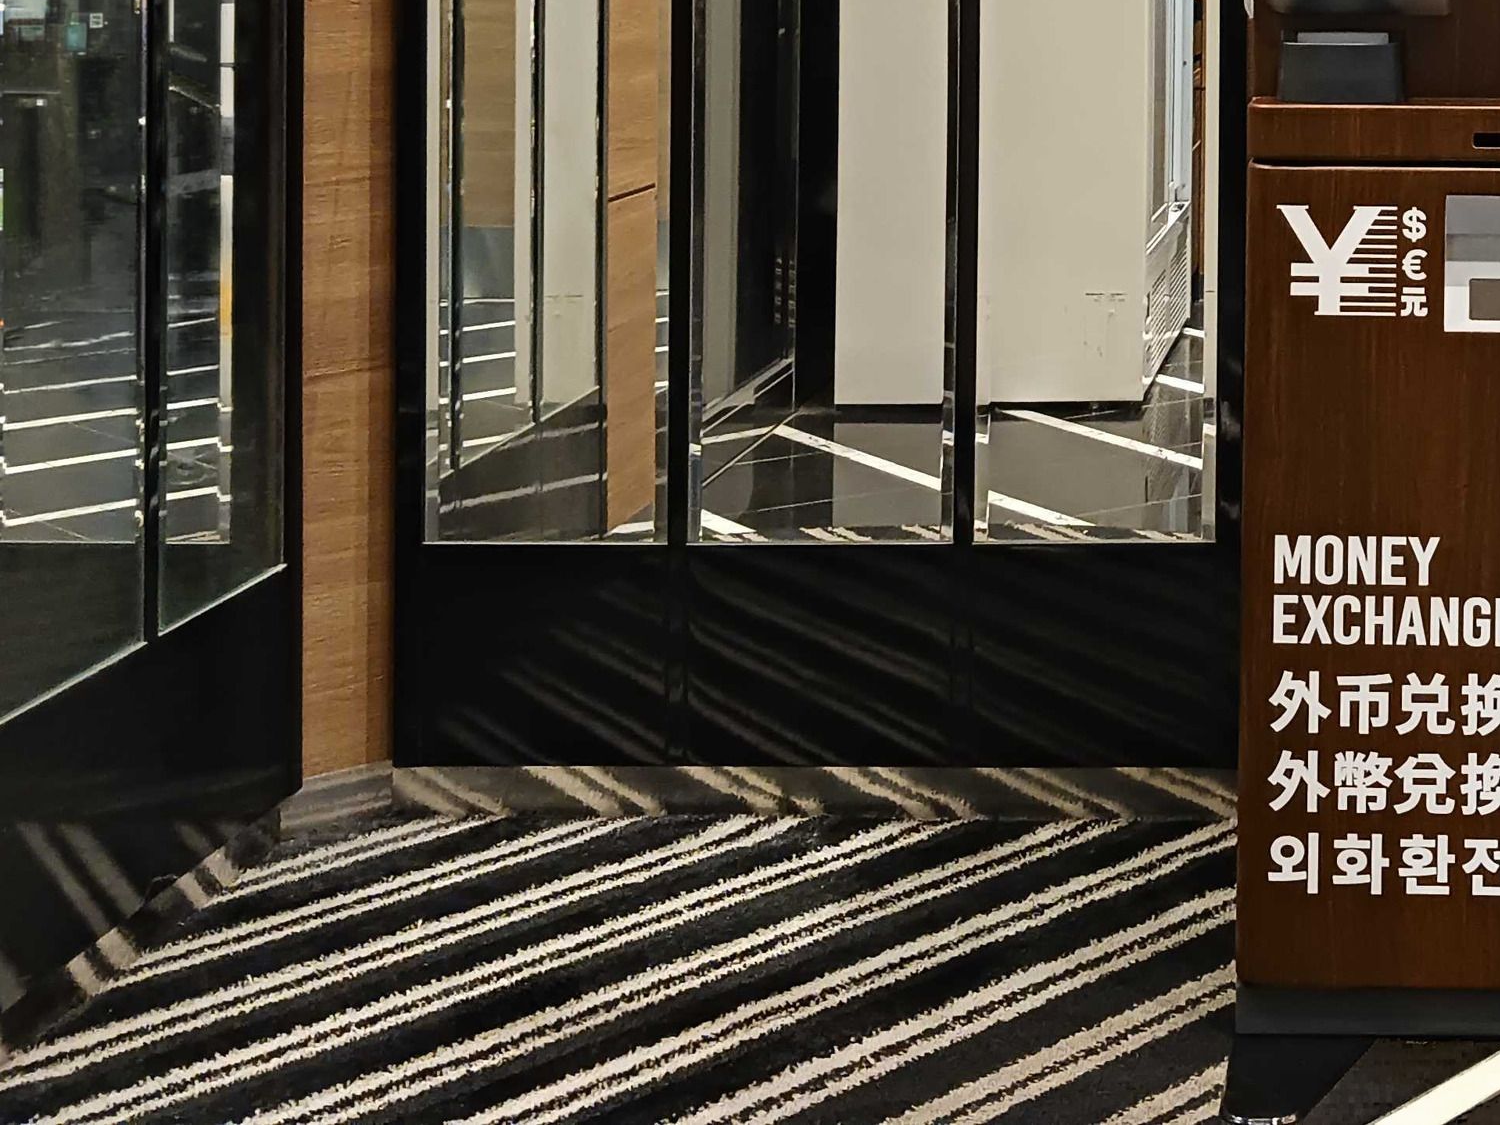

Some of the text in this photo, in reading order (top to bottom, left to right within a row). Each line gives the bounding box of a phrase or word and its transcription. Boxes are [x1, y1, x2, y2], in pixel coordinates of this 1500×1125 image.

[1402, 206, 1427, 242] $
[1402, 248, 1428, 281] €
[1400, 286, 1428, 317] 元
[1274, 534, 1440, 586] MONEY
